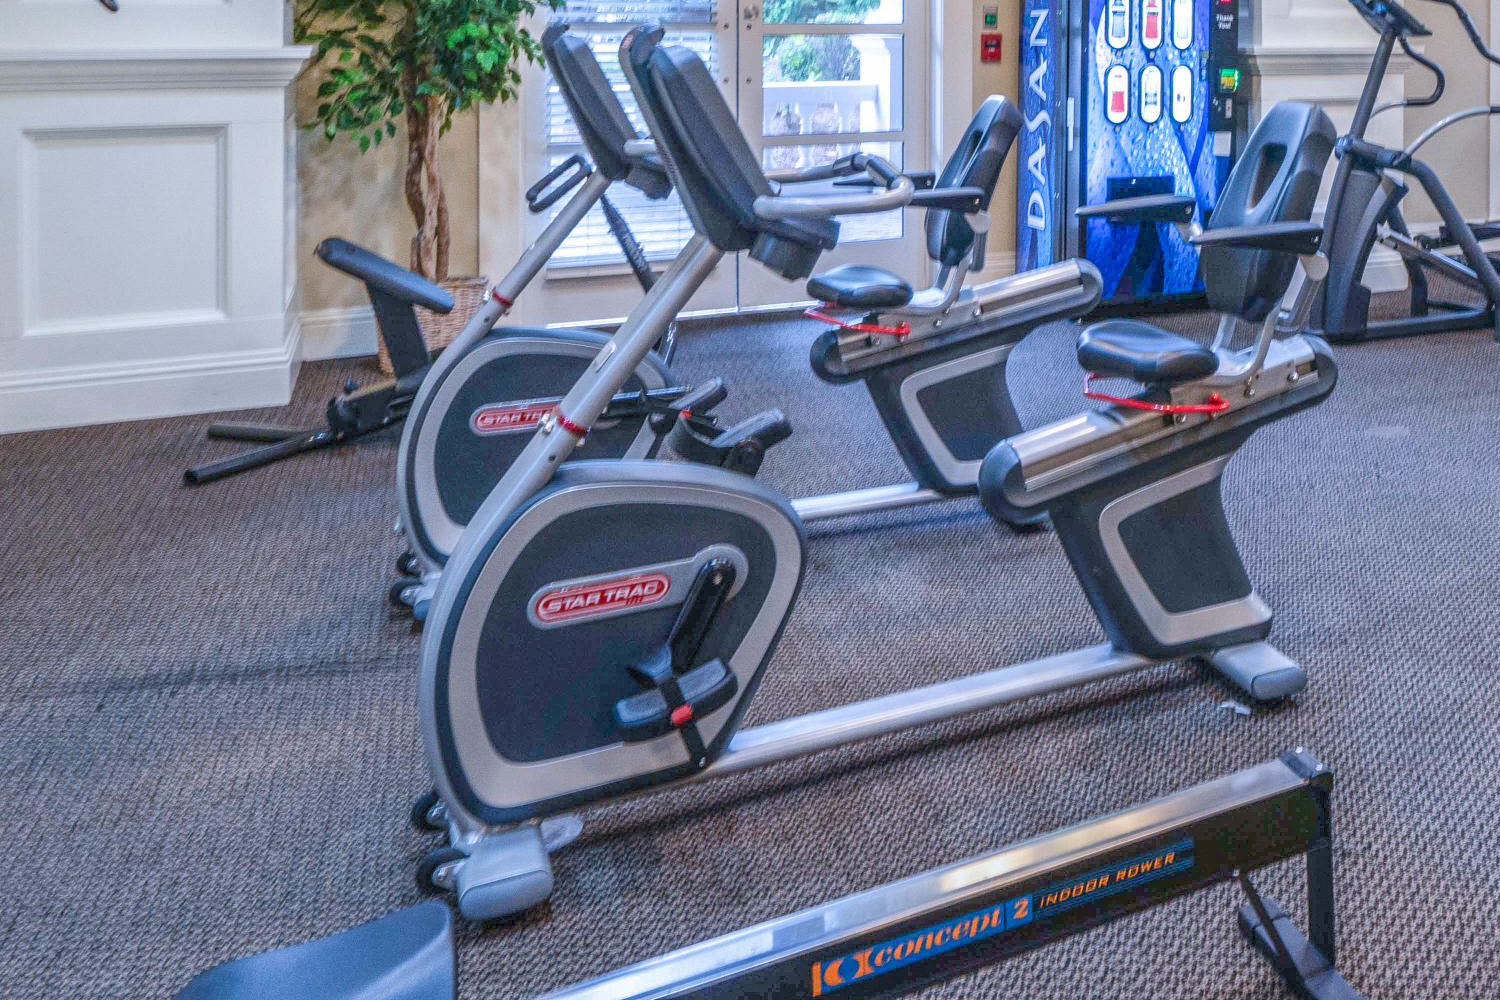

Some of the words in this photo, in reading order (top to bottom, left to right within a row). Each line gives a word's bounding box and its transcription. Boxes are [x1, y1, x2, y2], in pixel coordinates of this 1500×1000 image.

[484, 413, 522, 426] STAR
[547, 592, 601, 613] STAR
[604, 582, 659, 602] TRAC
[873, 907, 1003, 967] concept
[1013, 898, 1030, 920] 2
[1039, 874, 1110, 909] INDOOR
[1115, 852, 1176, 882] ROWER
